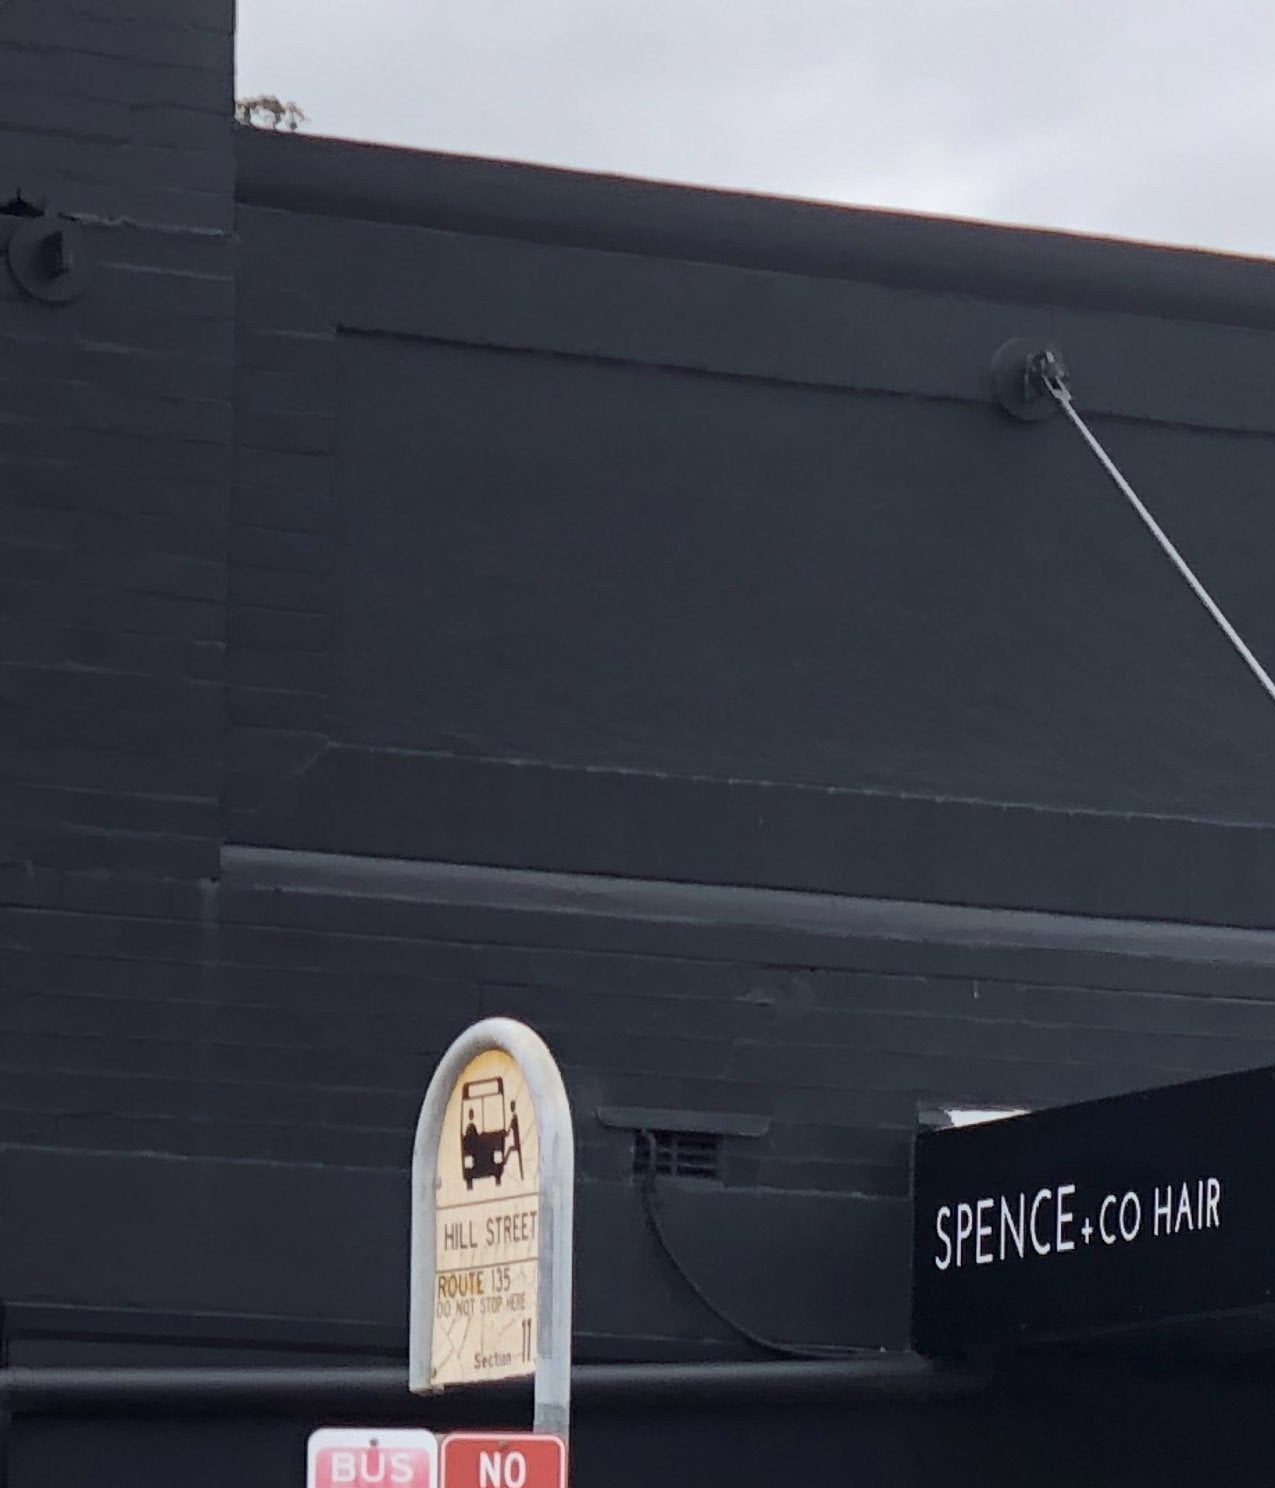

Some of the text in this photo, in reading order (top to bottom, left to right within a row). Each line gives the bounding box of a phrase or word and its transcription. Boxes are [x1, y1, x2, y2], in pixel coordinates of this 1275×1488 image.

[1154, 1177, 1221, 1236] HAIR
[444, 1211, 537, 1250] HILL STREET
[438, 1267, 511, 1299] ROUTE 135
[436, 1292, 526, 1319] DO NOT STOP HERE
[474, 1318, 532, 1369] Section 11
[331, 1451, 413, 1483] BUS
